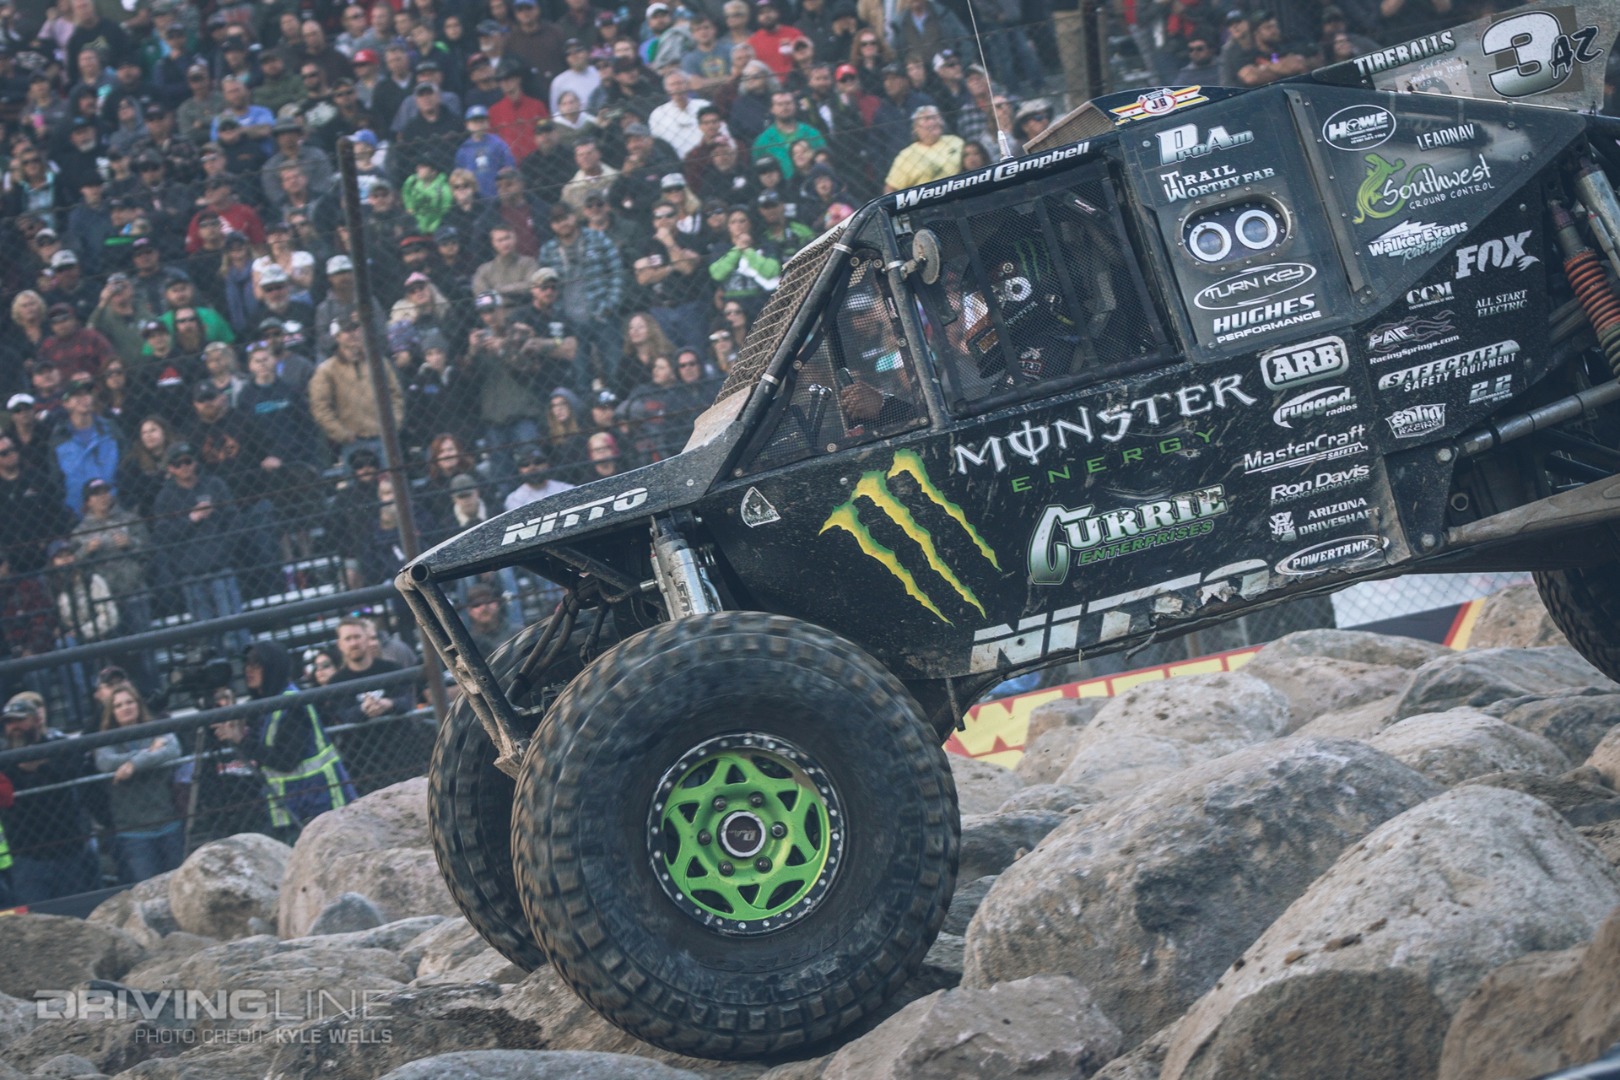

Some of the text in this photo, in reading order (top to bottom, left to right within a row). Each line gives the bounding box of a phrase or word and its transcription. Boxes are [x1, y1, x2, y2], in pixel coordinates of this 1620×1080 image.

[1354, 31, 1456, 77] TIREBALLS
[1481, 11, 1604, 98] 3 AZ
[1329, 112, 1388, 140] HOWE
[1416, 124, 1475, 151] LEADNAV
[895, 142, 1091, 211] Wayland Campbell
[1160, 164, 1236, 190] TRAIL
[1164, 167, 1275, 203] WORTHY FAB
[1383, 153, 1491, 205] Southwest
[1409, 183, 1496, 210] GROUND CONTROL
[1368, 222, 1468, 257] Walker Evans
[1455, 230, 1540, 279] FOX
[1204, 278, 1260, 299] TURN
[1406, 281, 1453, 304] CCM
[1475, 290, 1528, 309] ALL START
[1213, 293, 1316, 334] HUGHES
[1216, 310, 1322, 343] PERFORMANCE
[1477, 300, 1528, 318] ELECTRIC
[1273, 344, 1342, 383] ARB
[1369, 334, 1460, 365] RacingSprings.com
[1387, 344, 1504, 387] SAFECRAFT
[1404, 352, 1517, 392] SAFETY EQUIPMENT
[1280, 387, 1351, 421] rugged
[1325, 403, 1358, 417] radios
[954, 373, 1257, 475] MONSTER
[1011, 428, 1216, 493] ENERGY
[1244, 424, 1366, 471] MasterCraft
[1327, 445, 1360, 461] SAFETY
[1270, 464, 1370, 500] Ron Davis
[1270, 474, 1370, 506] RACING RADIATORS
[500, 487, 648, 546] NITTO
[1298, 507, 1380, 535] DRIVESHAFT
[1307, 497, 1368, 520] ARIZONA
[1028, 483, 1229, 585] CURRIE
[1078, 520, 1215, 566] ENTERPRISES
[1291, 540, 1370, 569] POWERTANK
